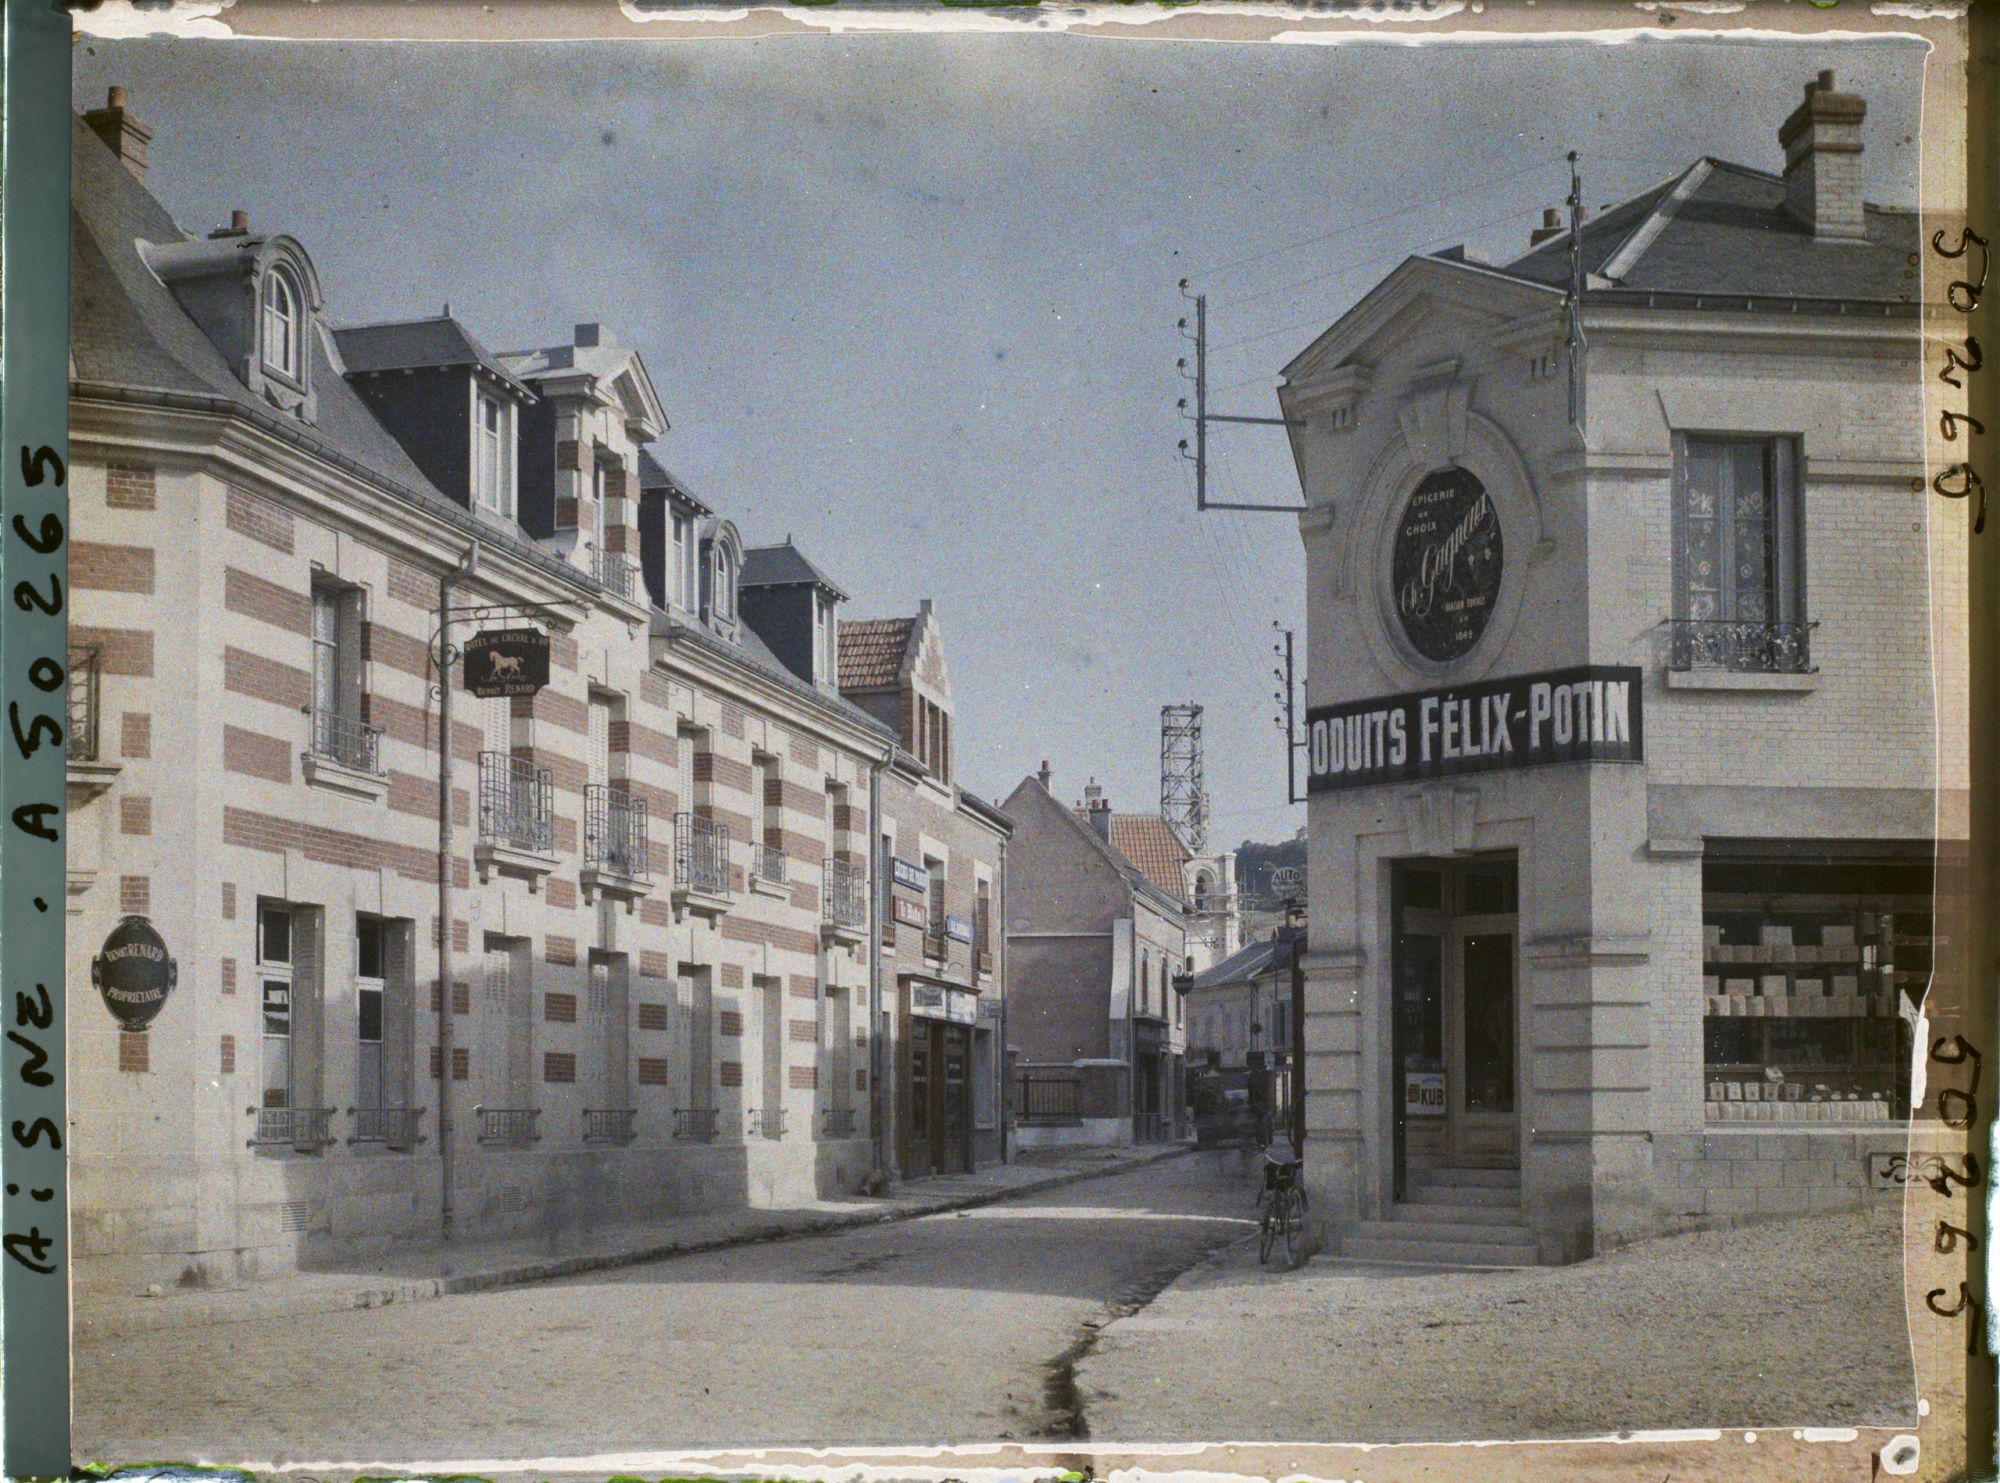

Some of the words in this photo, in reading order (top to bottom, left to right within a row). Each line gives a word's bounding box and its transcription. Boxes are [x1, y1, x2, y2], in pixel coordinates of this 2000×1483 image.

[1406, 521, 1437, 537] CHOIX
[502, 632, 529, 644] CHEVAL
[504, 683, 536, 696] RENARD
[1273, 869, 1300, 881] AUTO
[127, 943, 164, 962] RENARD
[1421, 1087, 1444, 1106] KUB
